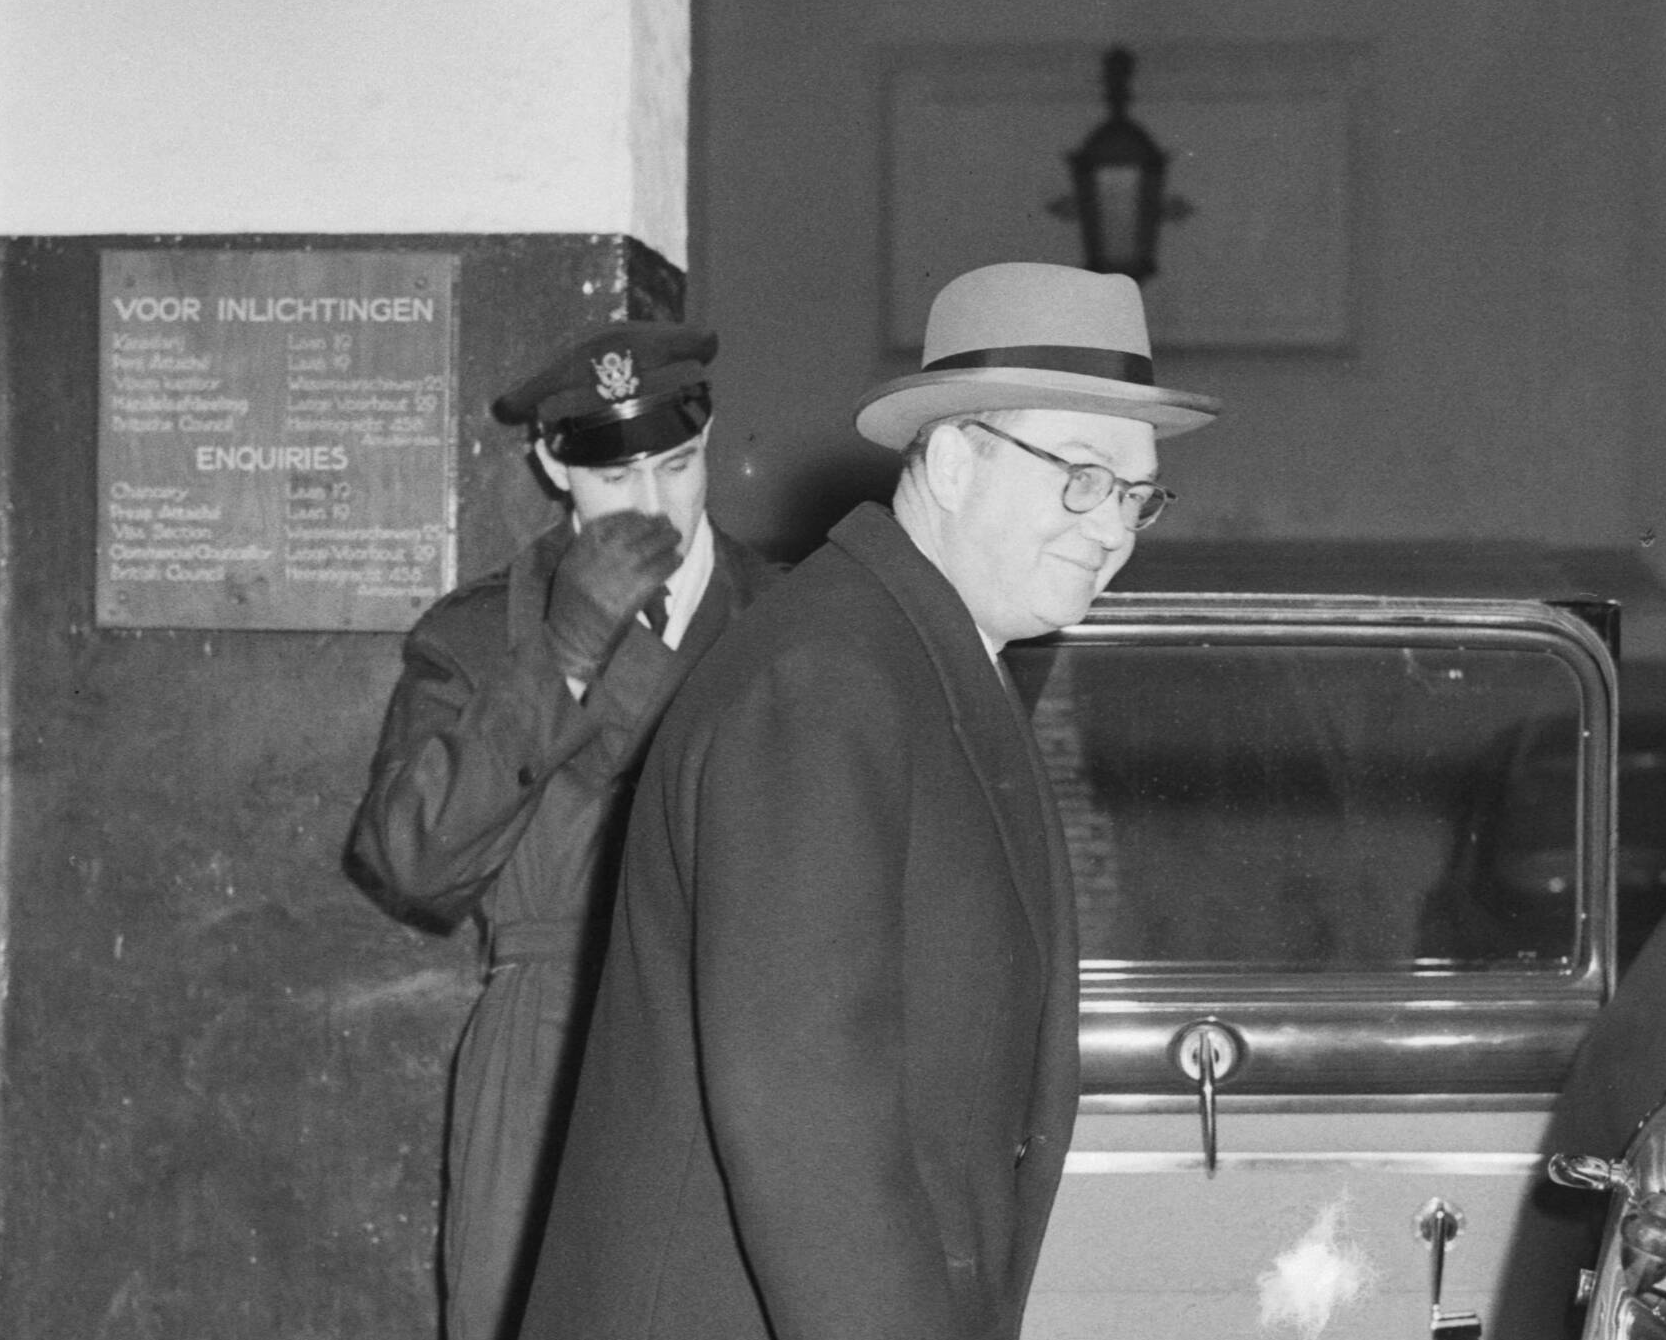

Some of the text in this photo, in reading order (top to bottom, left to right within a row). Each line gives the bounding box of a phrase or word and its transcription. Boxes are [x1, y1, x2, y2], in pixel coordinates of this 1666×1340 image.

[112, 295, 435, 323] VOOR INLICHTINGEN
[195, 445, 350, 473] ENQUIRIES
